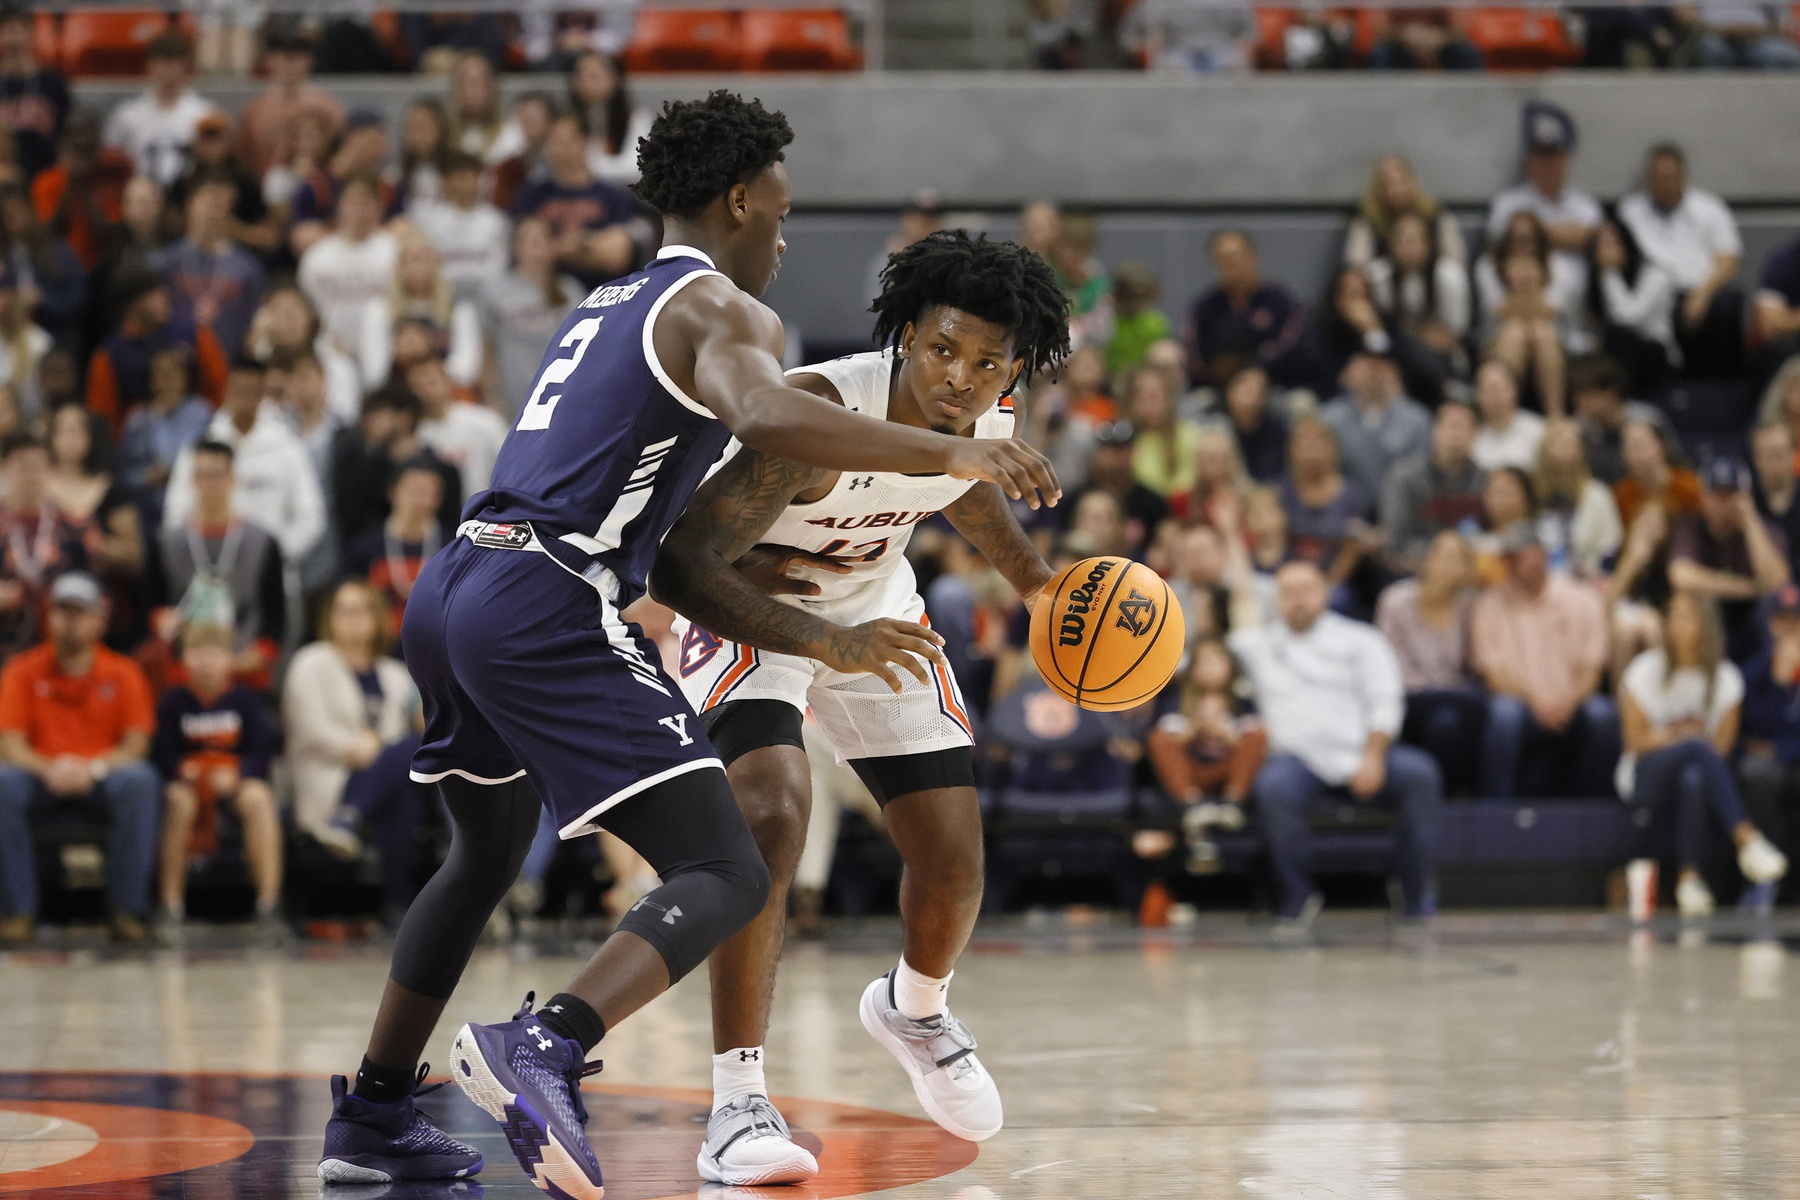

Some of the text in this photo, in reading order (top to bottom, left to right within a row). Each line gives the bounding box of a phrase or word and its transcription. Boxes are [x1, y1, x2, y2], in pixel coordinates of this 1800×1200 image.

[577, 276, 650, 309] MBENG
[516, 316, 604, 431] 2
[1059, 561, 1117, 647] Wilson
[1091, 583, 1107, 611] EVO NXT
[658, 713, 694, 747] Y
